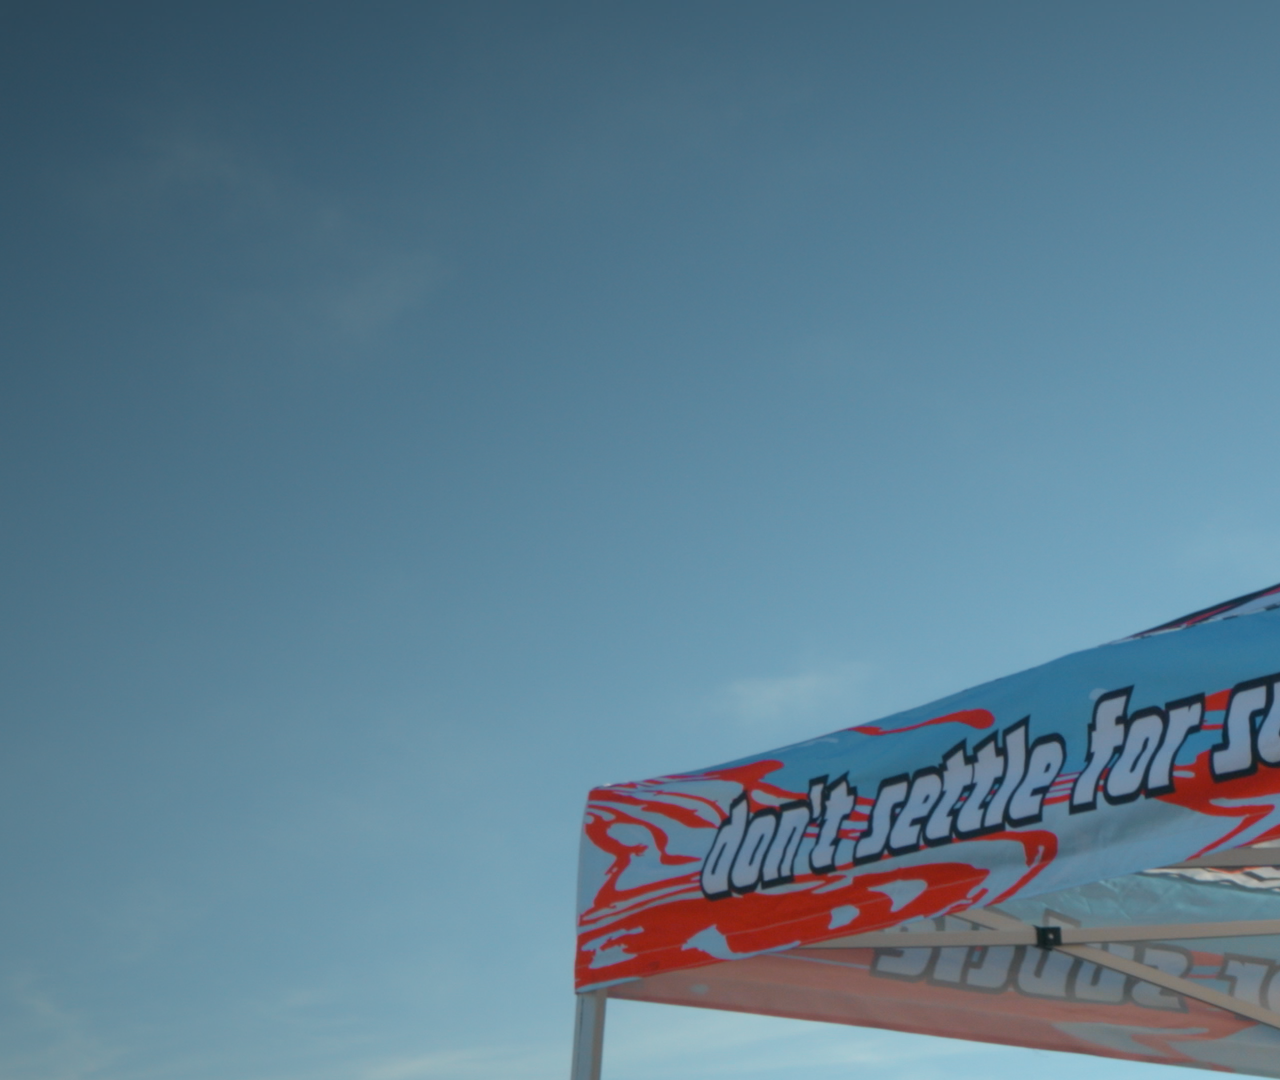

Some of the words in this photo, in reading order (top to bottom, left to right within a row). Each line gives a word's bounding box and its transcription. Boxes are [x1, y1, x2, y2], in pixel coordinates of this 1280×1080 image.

[699, 771, 858, 901] don't
[855, 716, 1066, 867] settle
[1068, 685, 1205, 814] for
